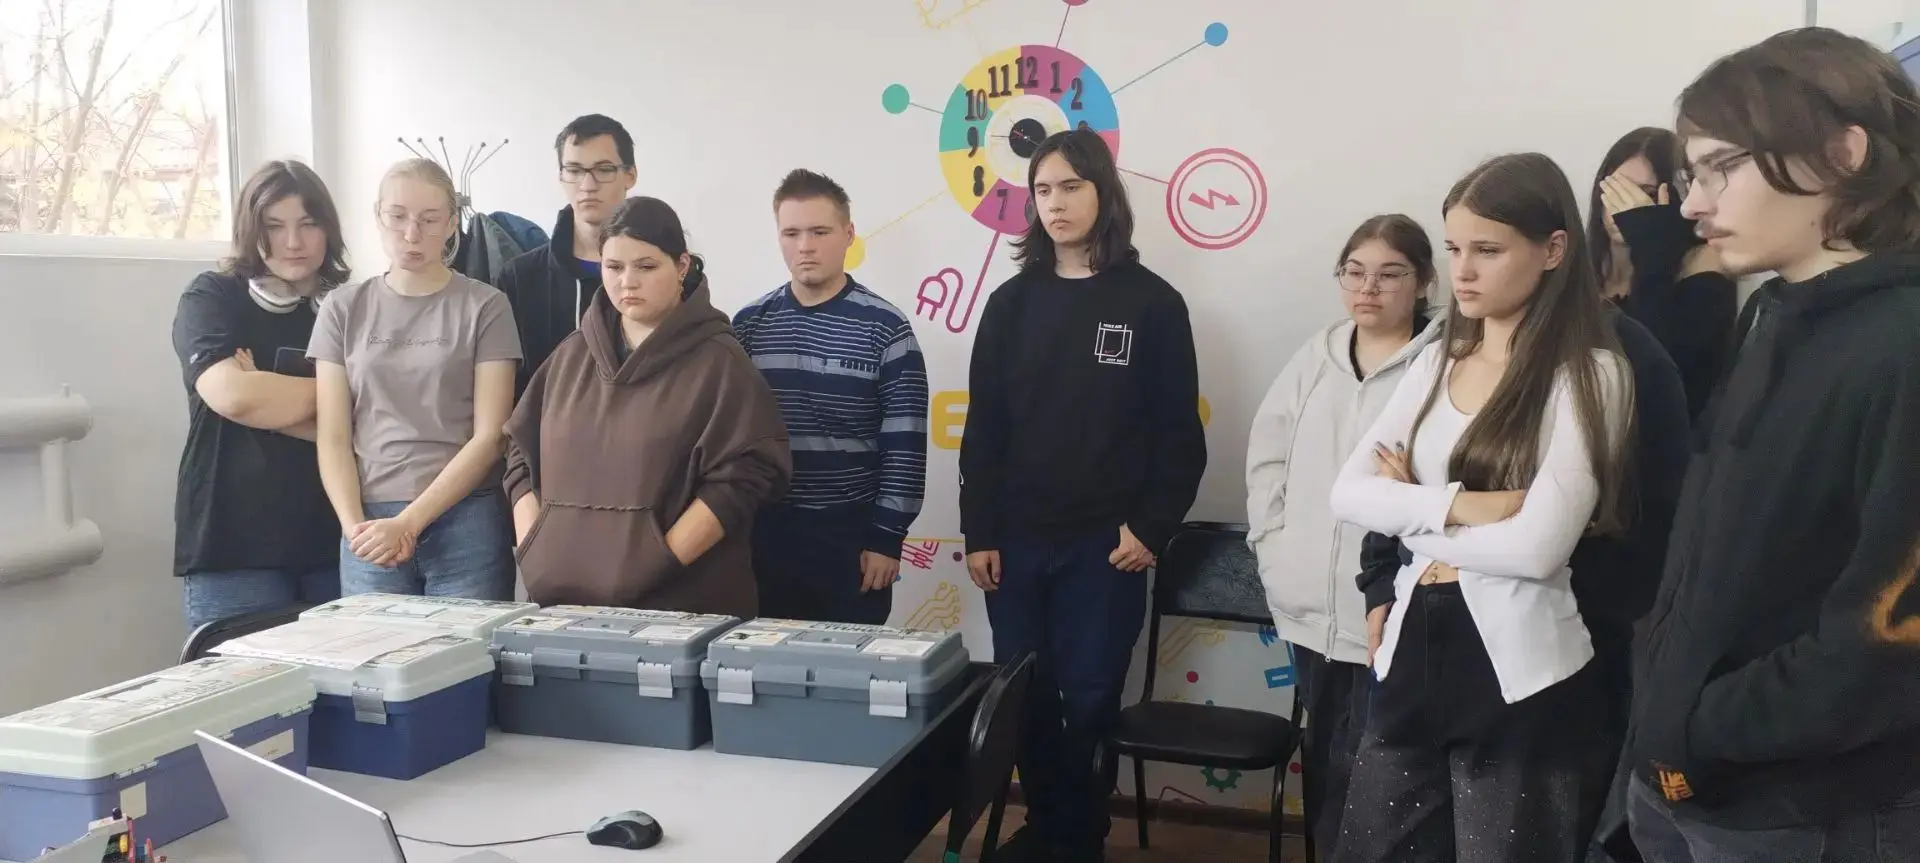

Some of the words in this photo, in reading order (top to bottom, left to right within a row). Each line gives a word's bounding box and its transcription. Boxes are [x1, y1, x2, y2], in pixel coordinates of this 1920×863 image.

[988, 64, 1012, 98] 11
[1015, 56, 1039, 89] 12
[1049, 61, 1063, 94] 1
[964, 89, 987, 121] 10
[1071, 77, 1083, 109] 2
[966, 126, 979, 158] 9
[973, 165, 985, 197] 8
[997, 188, 1008, 221] 7
